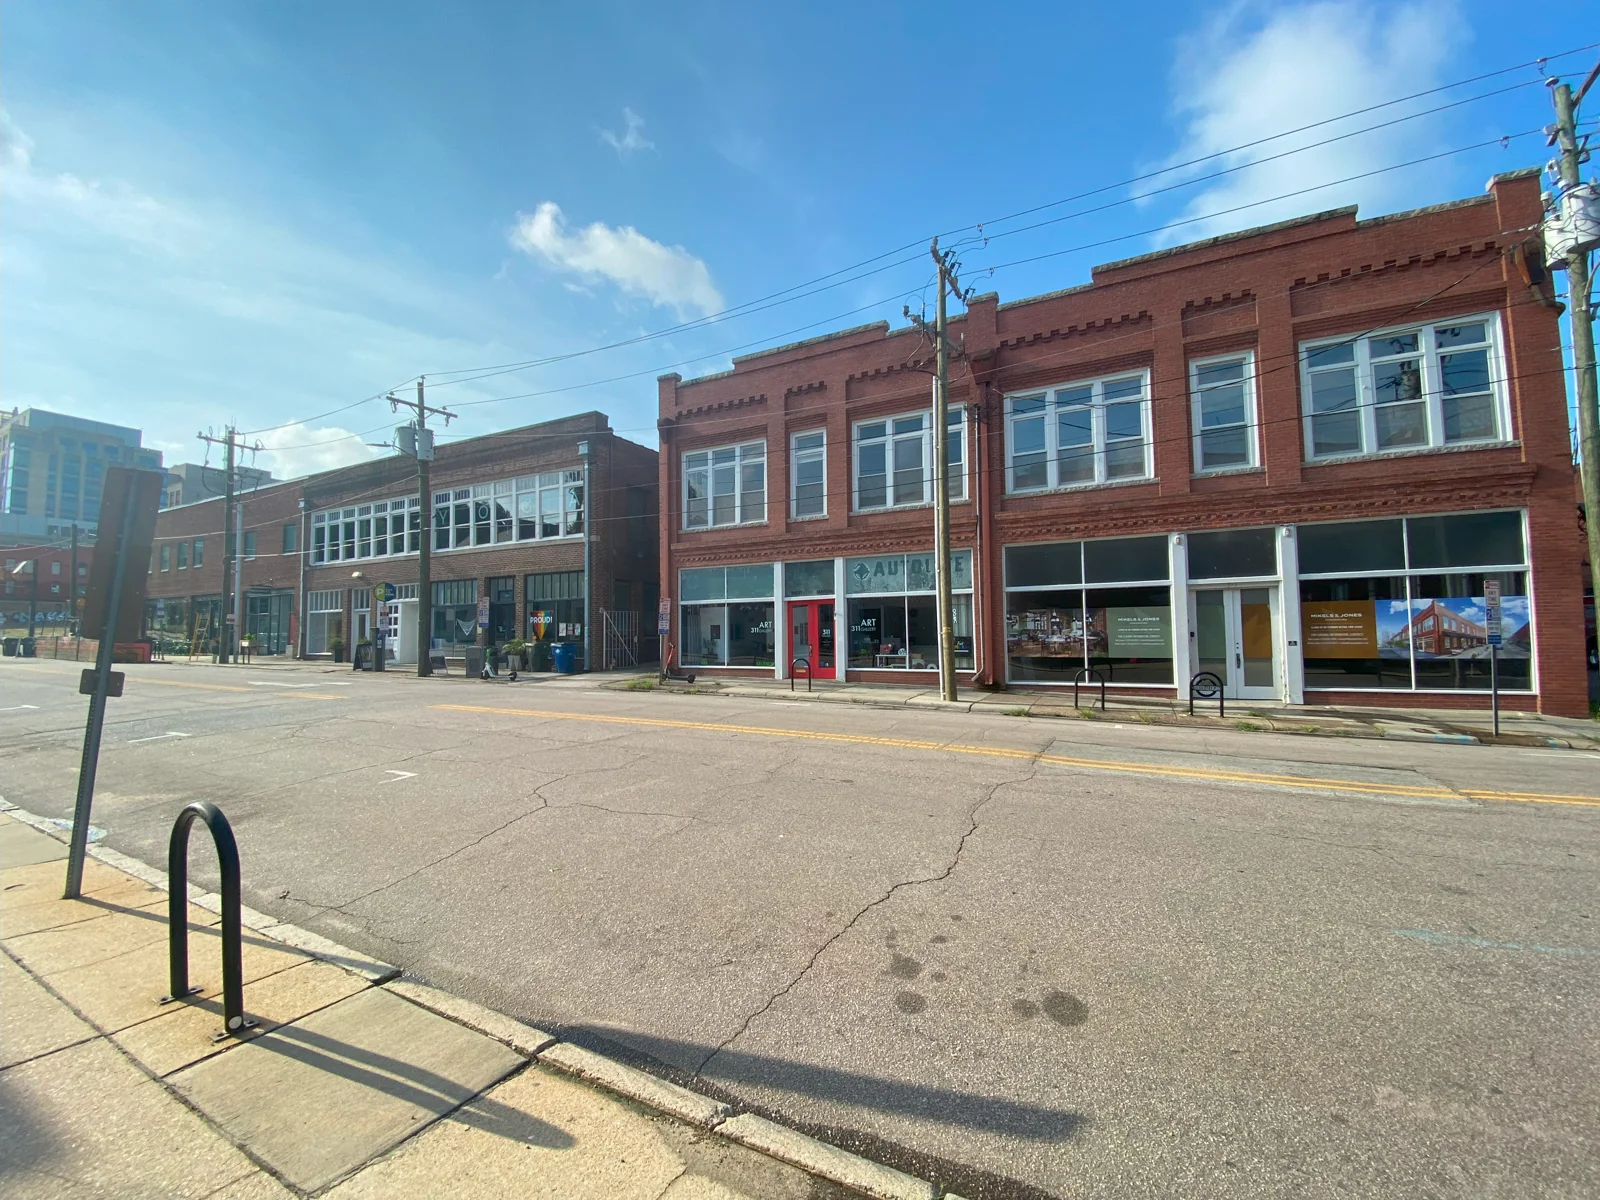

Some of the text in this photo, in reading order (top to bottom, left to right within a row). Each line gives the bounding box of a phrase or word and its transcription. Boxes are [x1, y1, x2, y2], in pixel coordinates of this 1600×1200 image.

[873, 556, 964, 577] AUTOLE
[530, 616, 553, 624] PROUD!
[860, 618, 877, 627] ART
[759, 621, 773, 629] ART
